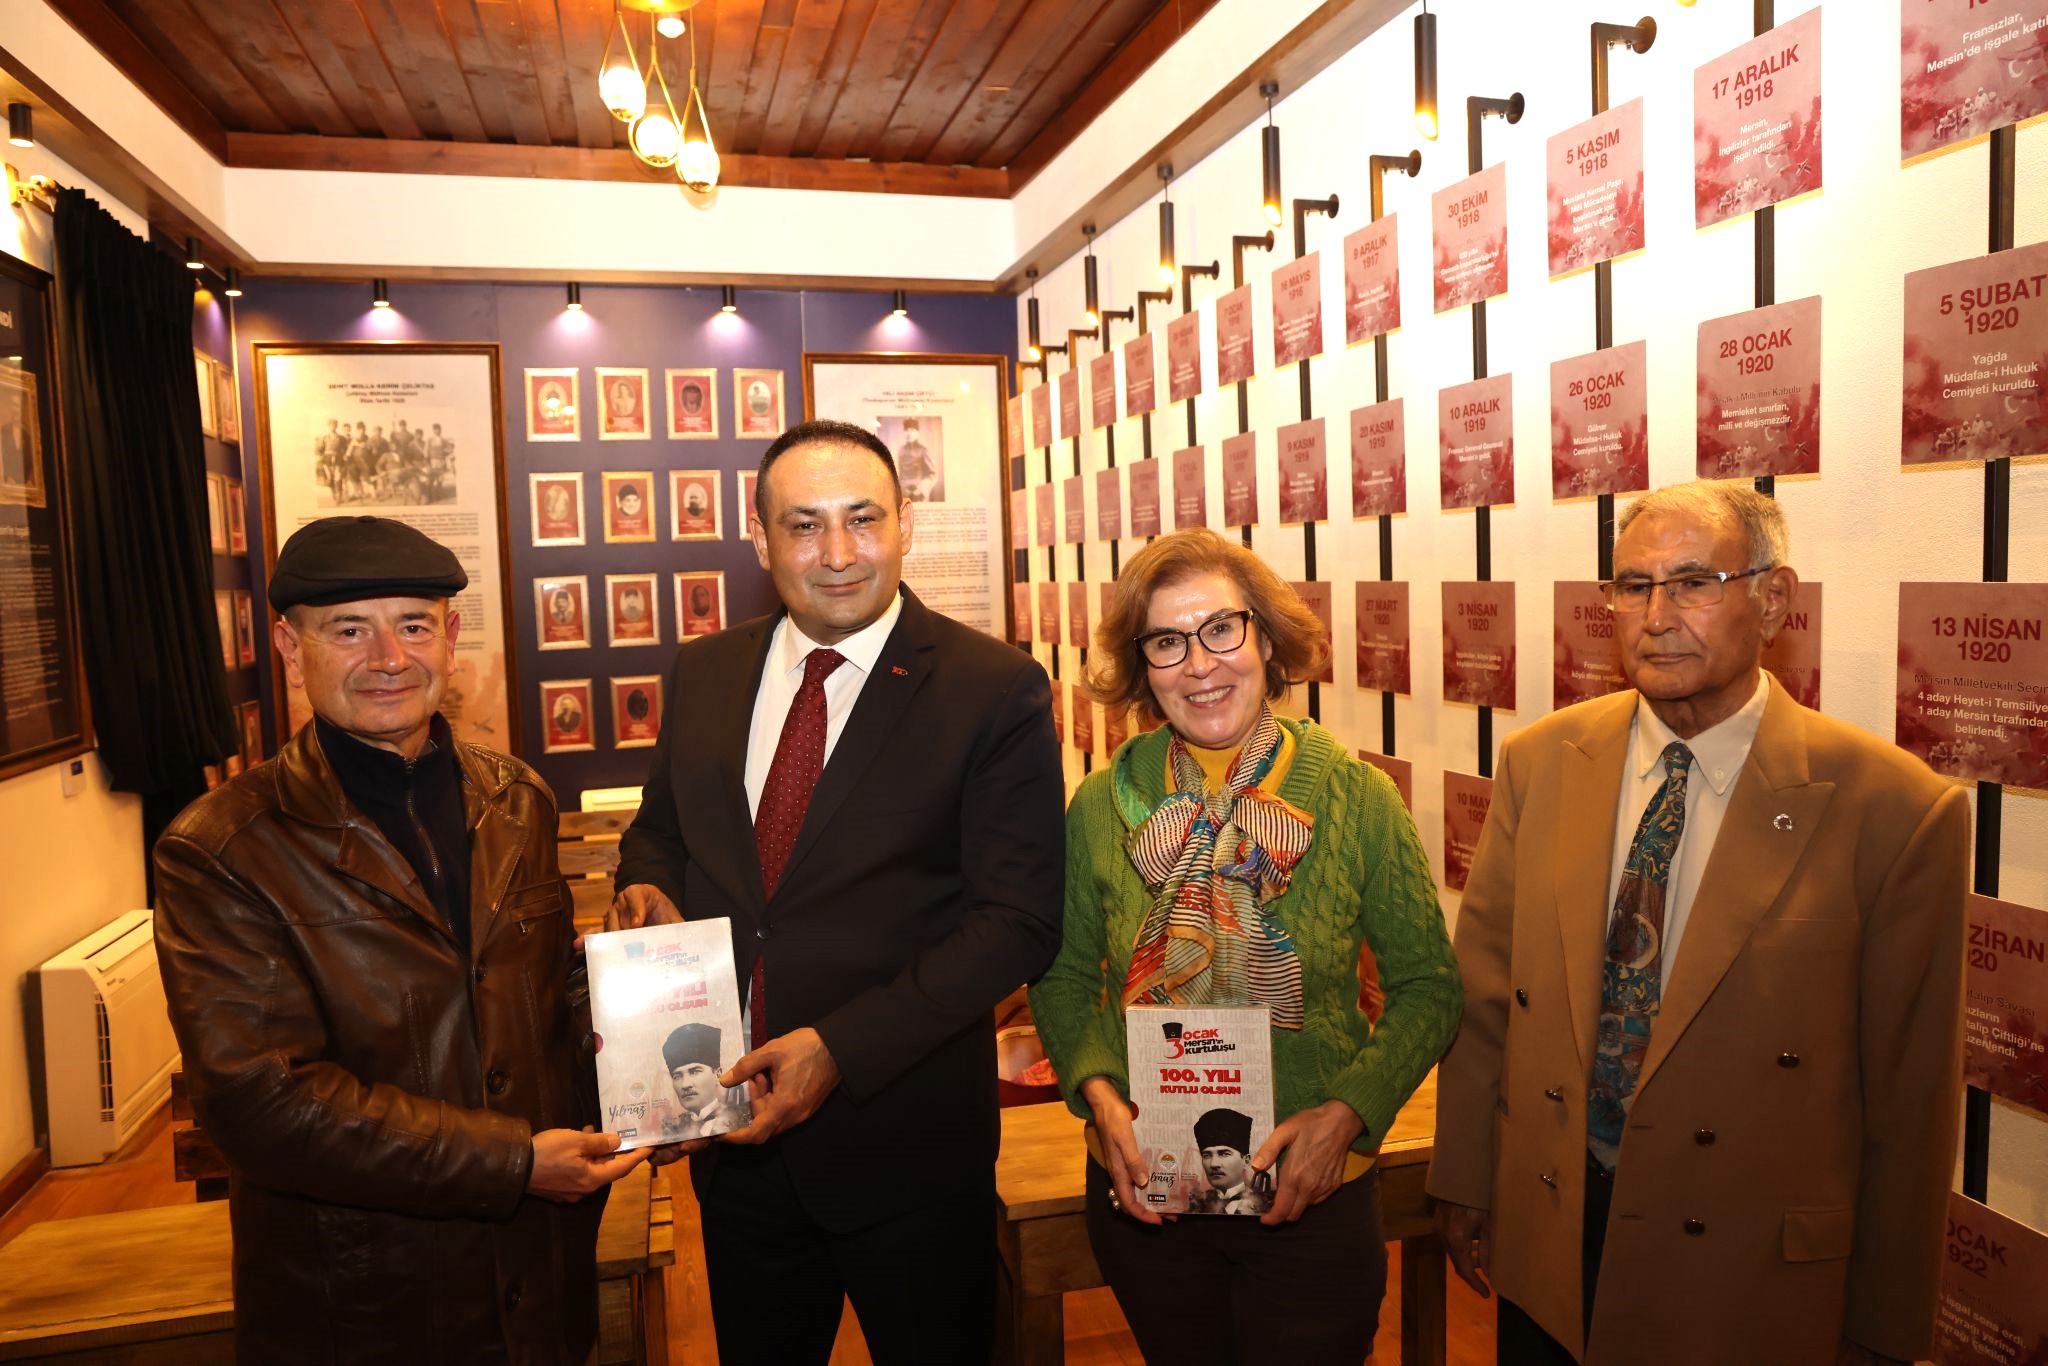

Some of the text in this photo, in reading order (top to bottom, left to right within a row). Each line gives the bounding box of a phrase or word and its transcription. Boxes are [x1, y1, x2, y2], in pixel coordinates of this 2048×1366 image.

[1927, 47, 1981, 73] Mersin'de
[1984, 29, 2019, 51] işgale
[1712, 44, 1799, 100] 17 ARALIK
[1735, 79, 1774, 110] 1918
[1566, 128, 1620, 165] 5 KASIM
[1579, 153, 1608, 177] 1918
[1448, 190, 1488, 219] 30 EKİM
[1458, 209, 1480, 230] 1918
[1360, 235, 1388, 255] ARALIK
[1363, 253, 1379, 270] 1917
[1939, 274, 2047, 317] 5 ŞUBAT
[1964, 307, 2019, 335] 1920
[1719, 328, 1793, 358] 28 OCAK
[1737, 353, 1774, 376] 1920
[1972, 352, 2008, 366] Yağda
[1944, 362, 2039, 385] Müdafaa-i Hukuk
[1568, 371, 1625, 398] 26 OCAK
[1942, 378, 2039, 399] Cemiyeti kuruldu.
[1450, 398, 1501, 421] 10 ARALIK
[1583, 392, 1612, 412] 1920
[1721, 406, 1758, 419] Memleket
[1734, 421, 1743, 429] ve
[1744, 413, 1793, 429] değişmezdir.
[1370, 419, 1394, 436] KASIM
[1464, 417, 1486, 433] 1919
[1294, 437, 1316, 451] KASIM
[1376, 599, 1398, 613] MART
[1458, 600, 1498, 617] 3 NİSAN
[1573, 606, 1581, 621] 5
[1467, 618, 1489, 631] 1920
[1585, 624, 1613, 639] 1920
[1931, 612, 2041, 641] 13 NİSAN
[1957, 641, 2012, 663] 1920
[1917, 691, 1924, 701] 4
[1926, 693, 1951, 705] aday
[1953, 694, 1992, 708] Heyet-i
[1918, 706, 1924, 715] 1
[1926, 707, 1951, 720] aday
[1954, 709, 1990, 722] Mersin
[1955, 723, 2008, 738] belirlendi.
[1456, 792, 1467, 806] 10
[1968, 947, 1998, 972] 20
[1966, 1007, 2000, 1024] ızların
[1991, 1027, 2045, 1053] Çiftliği'ne
[1160, 1068, 1241, 1083] 100. YILI
[1160, 1085, 1241, 1094] KUTLU OLSUN
[609, 1104, 646, 1124] Yılmaz
[1148, 1171, 1176, 1189] lmaz
